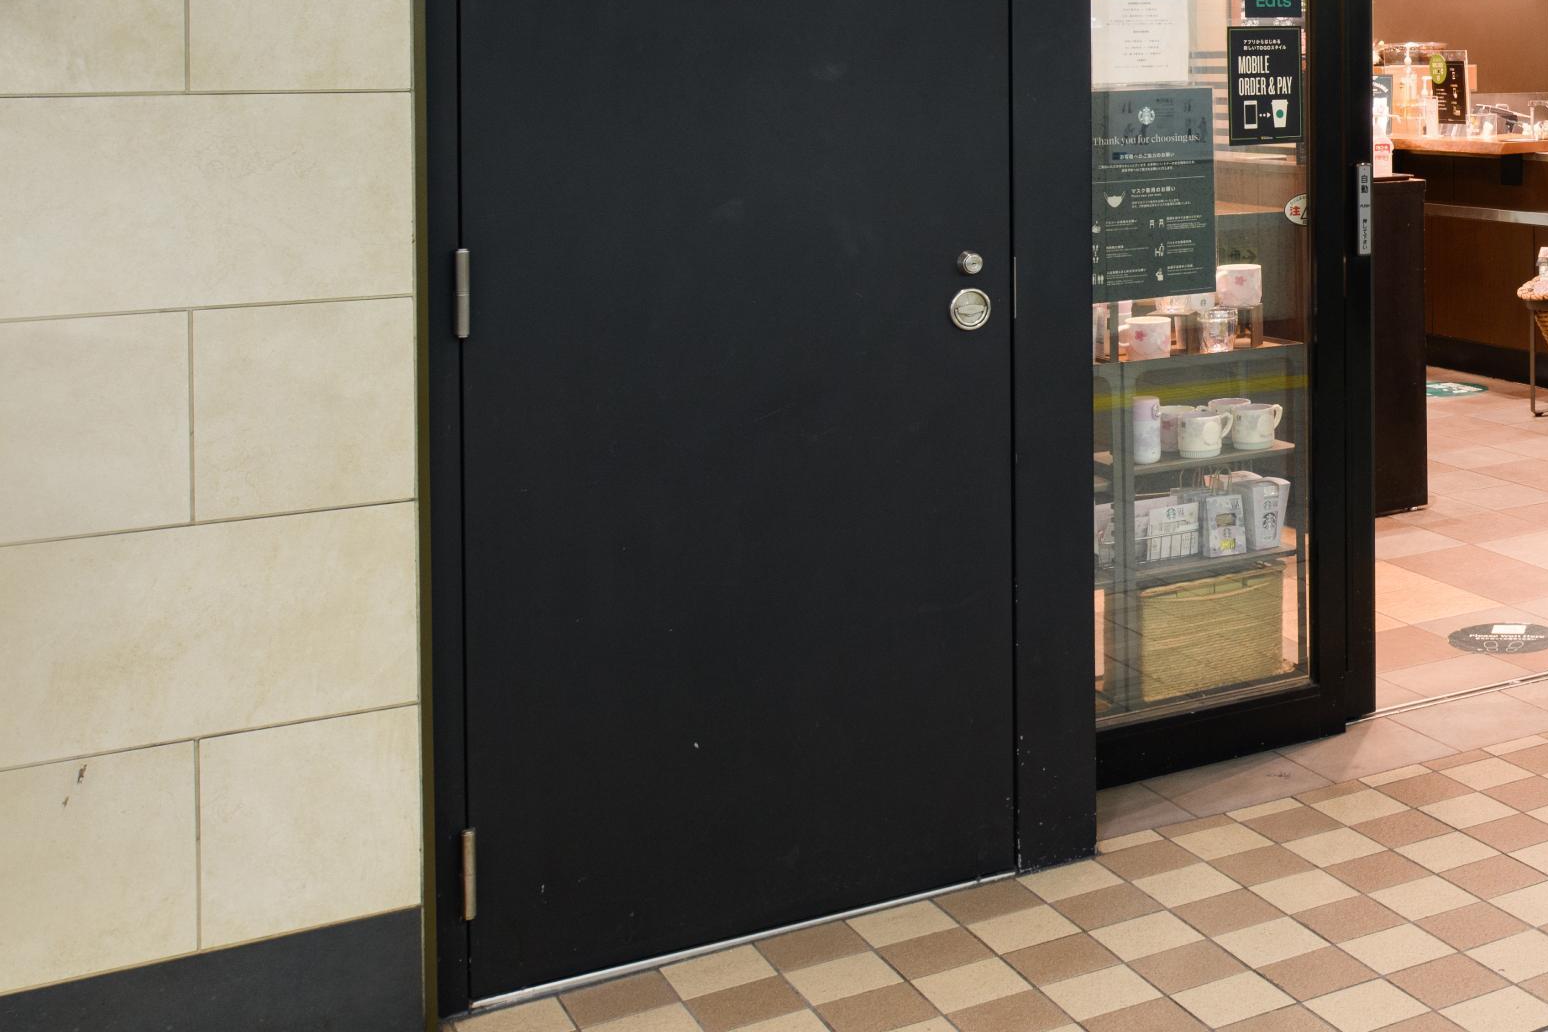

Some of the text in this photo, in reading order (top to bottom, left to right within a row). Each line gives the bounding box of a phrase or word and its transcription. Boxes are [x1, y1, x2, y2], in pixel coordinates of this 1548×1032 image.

[1238, 56, 1270, 74] MOBILE
[1238, 76, 1293, 96] ORDER & PAY
[1093, 136, 1120, 146] Thank
[1120, 136, 1137, 146] you
[1137, 134, 1150, 144] for
[1151, 133, 1188, 144] choosing
